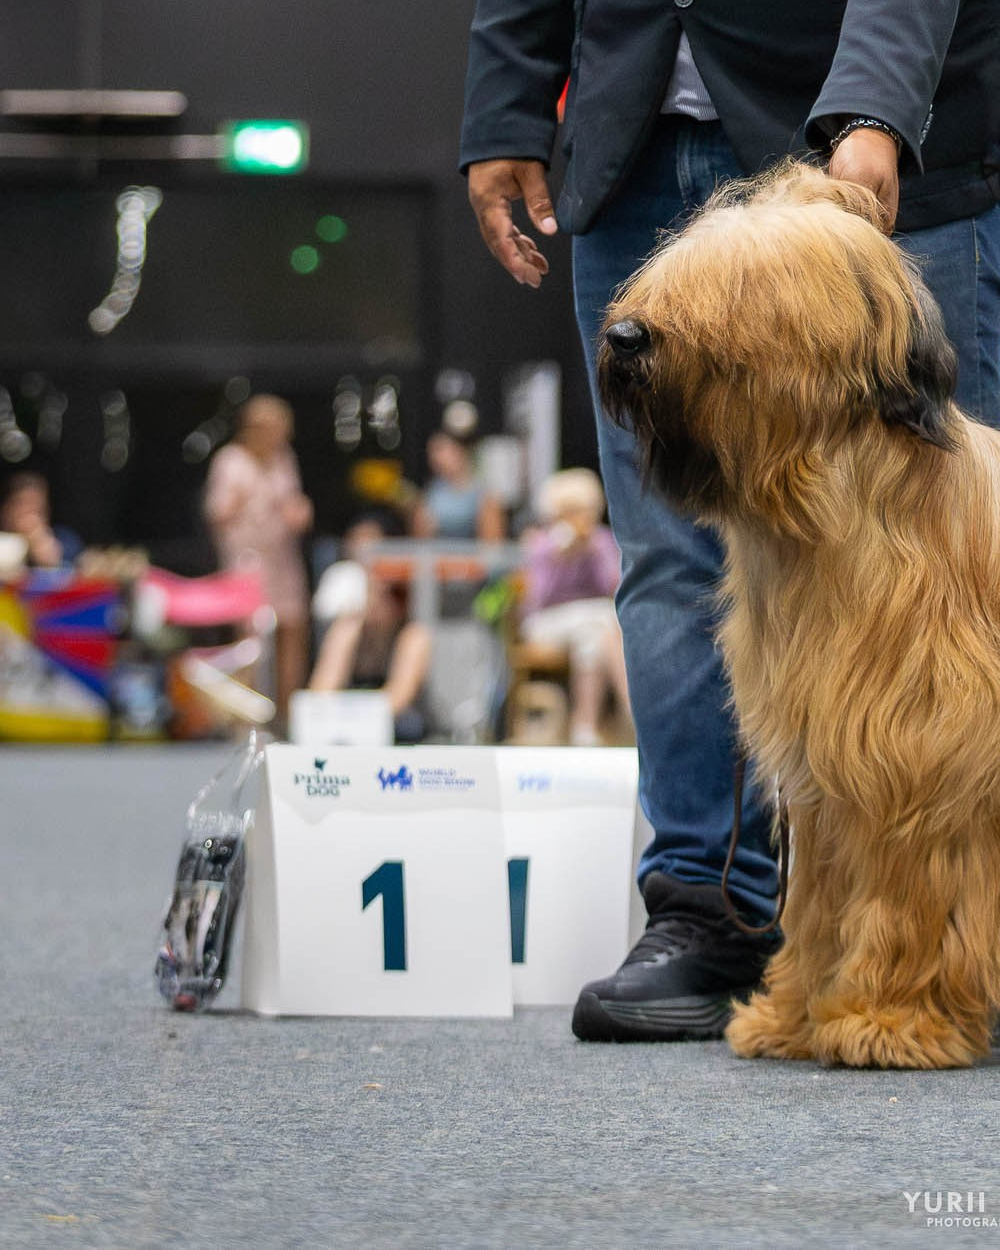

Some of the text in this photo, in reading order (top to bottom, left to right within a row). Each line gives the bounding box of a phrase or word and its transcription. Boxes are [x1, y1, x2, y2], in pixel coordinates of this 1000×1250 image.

[293, 768, 351, 788] Prima
[305, 785, 340, 798] DOG
[362, 861, 407, 971] 1
